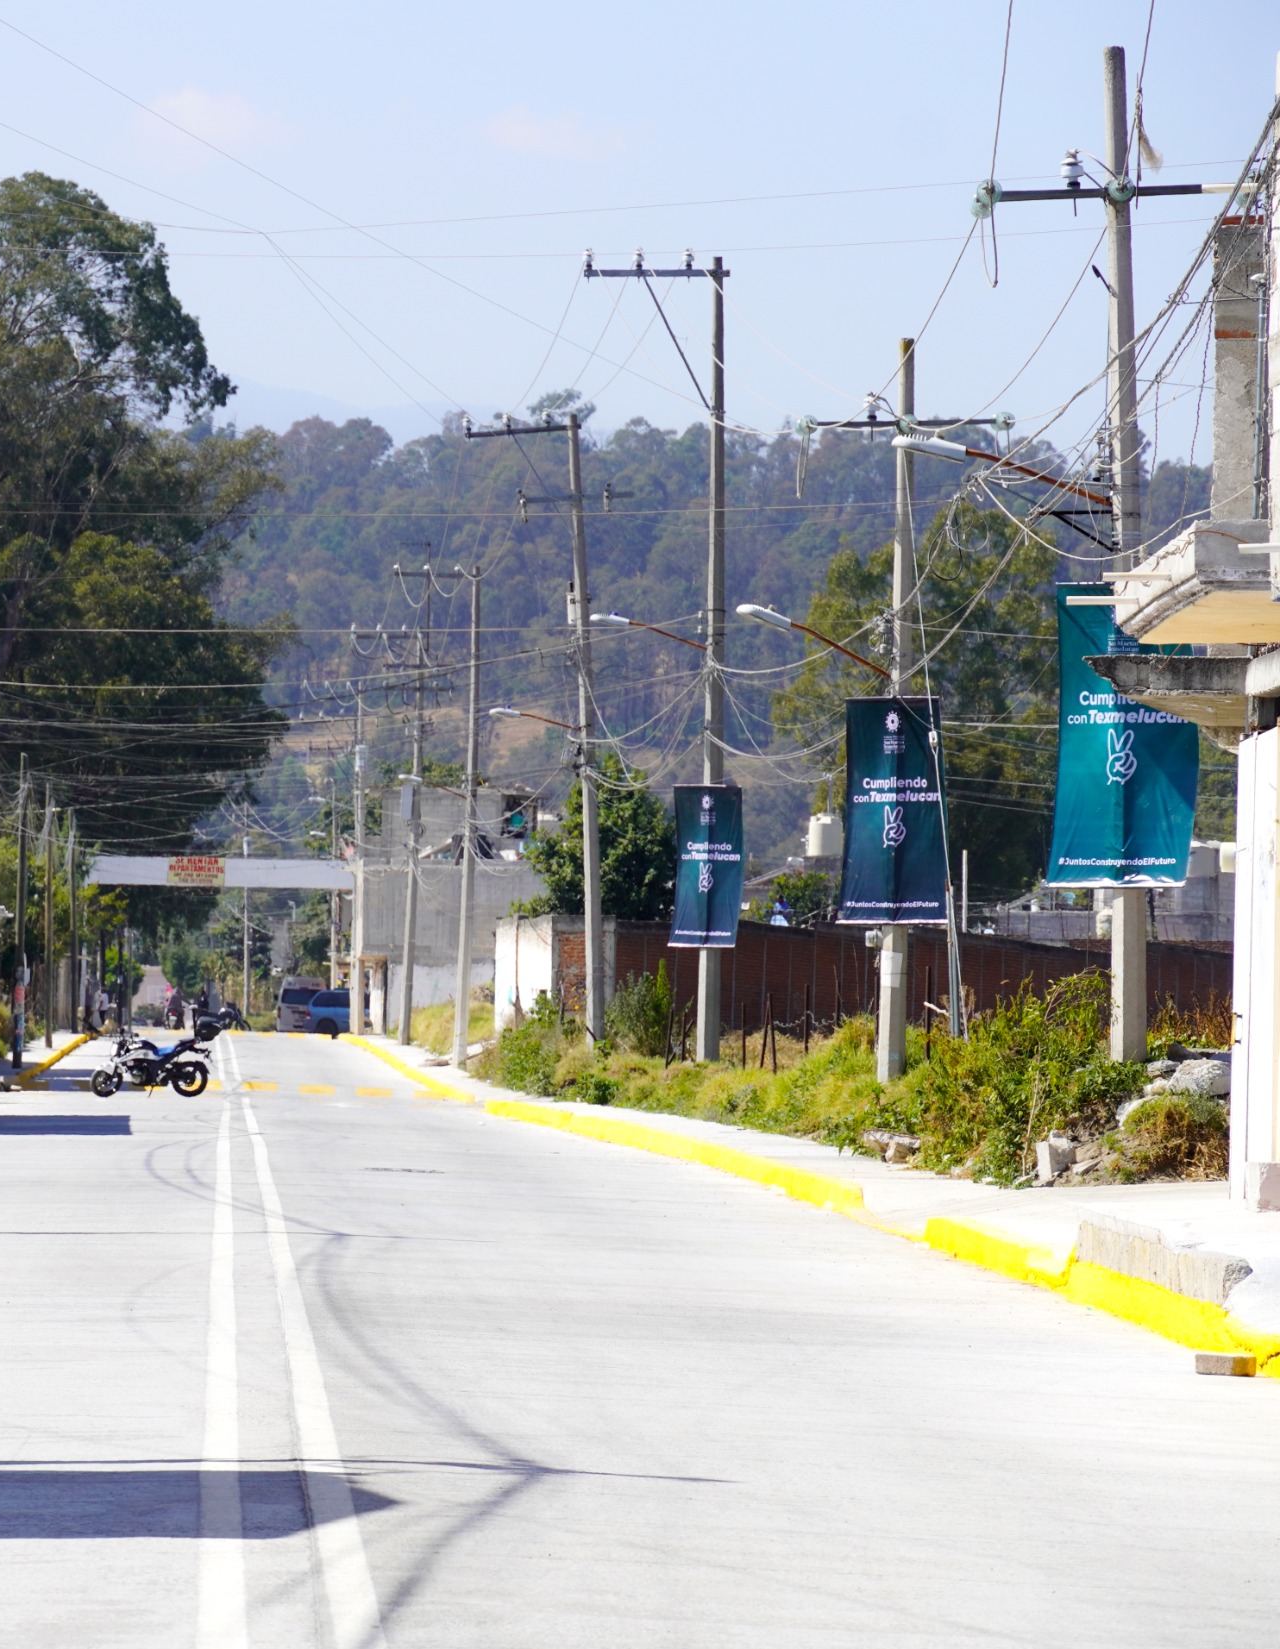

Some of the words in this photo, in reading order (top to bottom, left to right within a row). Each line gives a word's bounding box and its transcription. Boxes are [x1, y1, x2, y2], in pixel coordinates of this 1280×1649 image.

[1067, 714, 1088, 725] con
[863, 777, 927, 790] Cumpliendo
[853, 794, 869, 803] con
[869, 791, 941, 802] Texmelucan
[686, 841, 732, 851] Cumpliendo
[1058, 857, 1176, 867] #JuntosConstruyendoElFuturo
